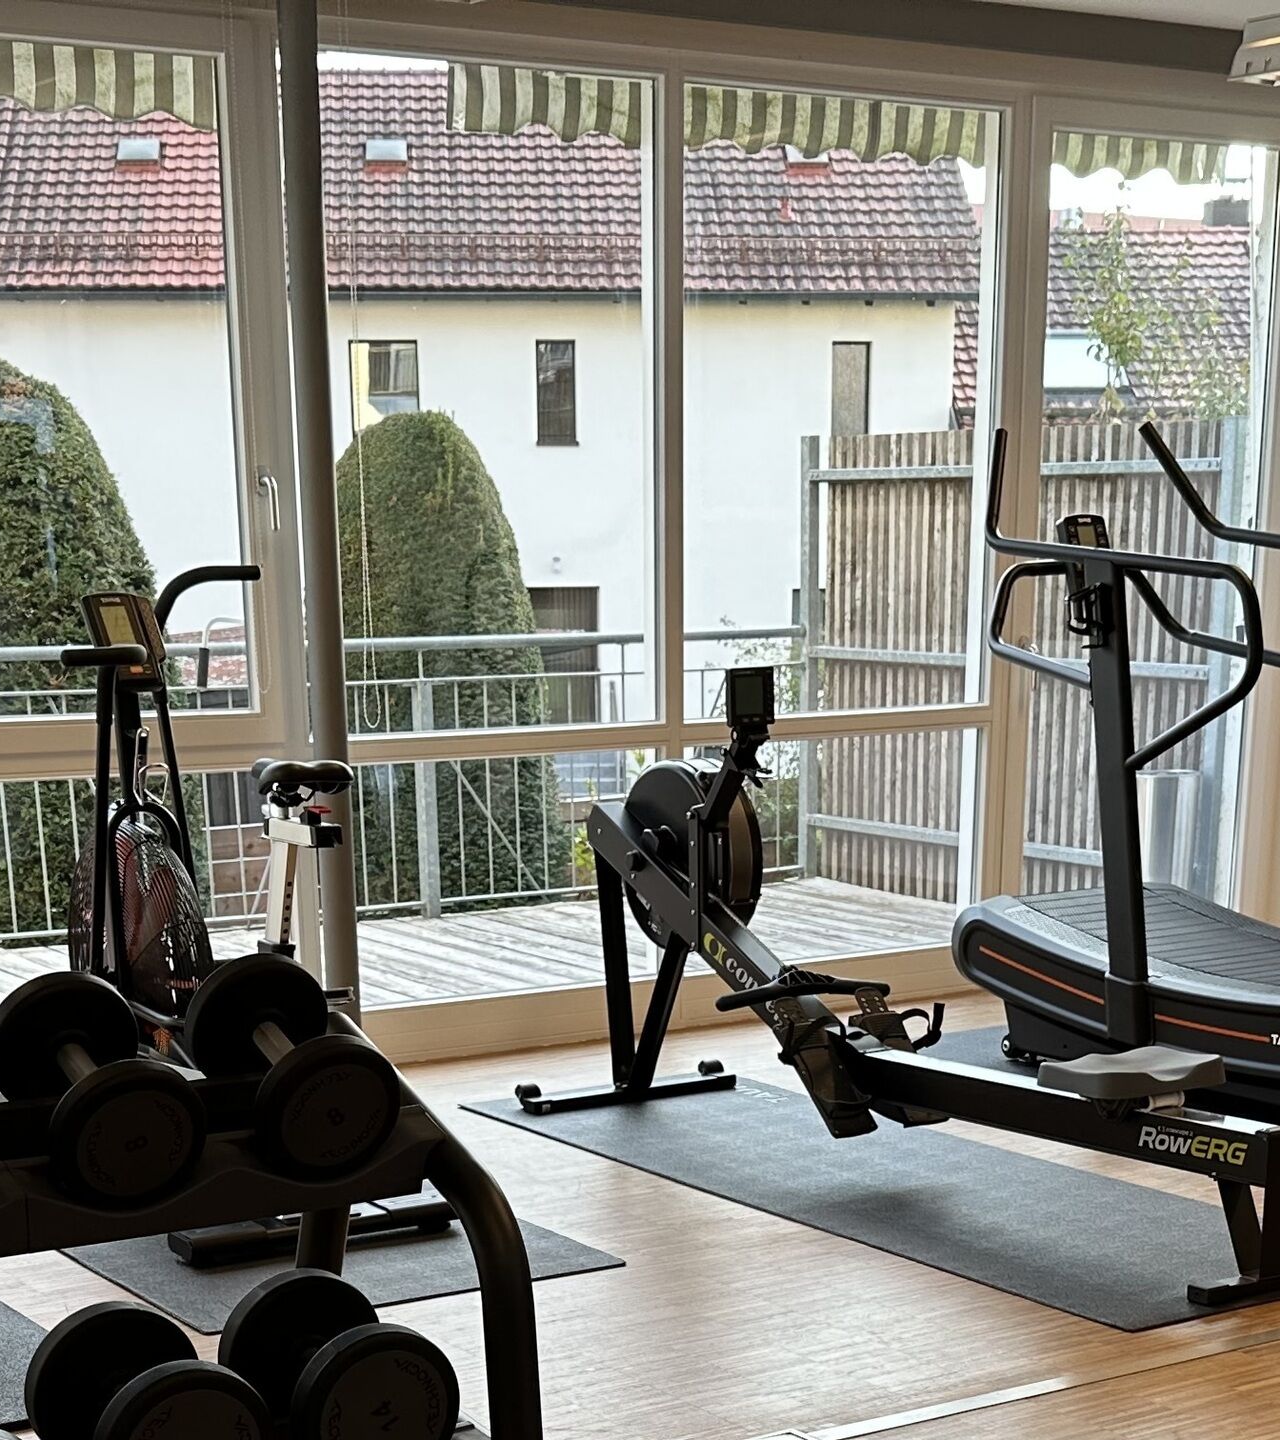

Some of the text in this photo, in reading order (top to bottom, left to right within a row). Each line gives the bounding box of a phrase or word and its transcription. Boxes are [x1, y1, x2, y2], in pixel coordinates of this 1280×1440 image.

[327, 1108, 344, 1126] 8
[125, 1136, 149, 1152] 8
[370, 1400, 400, 1431] 14
